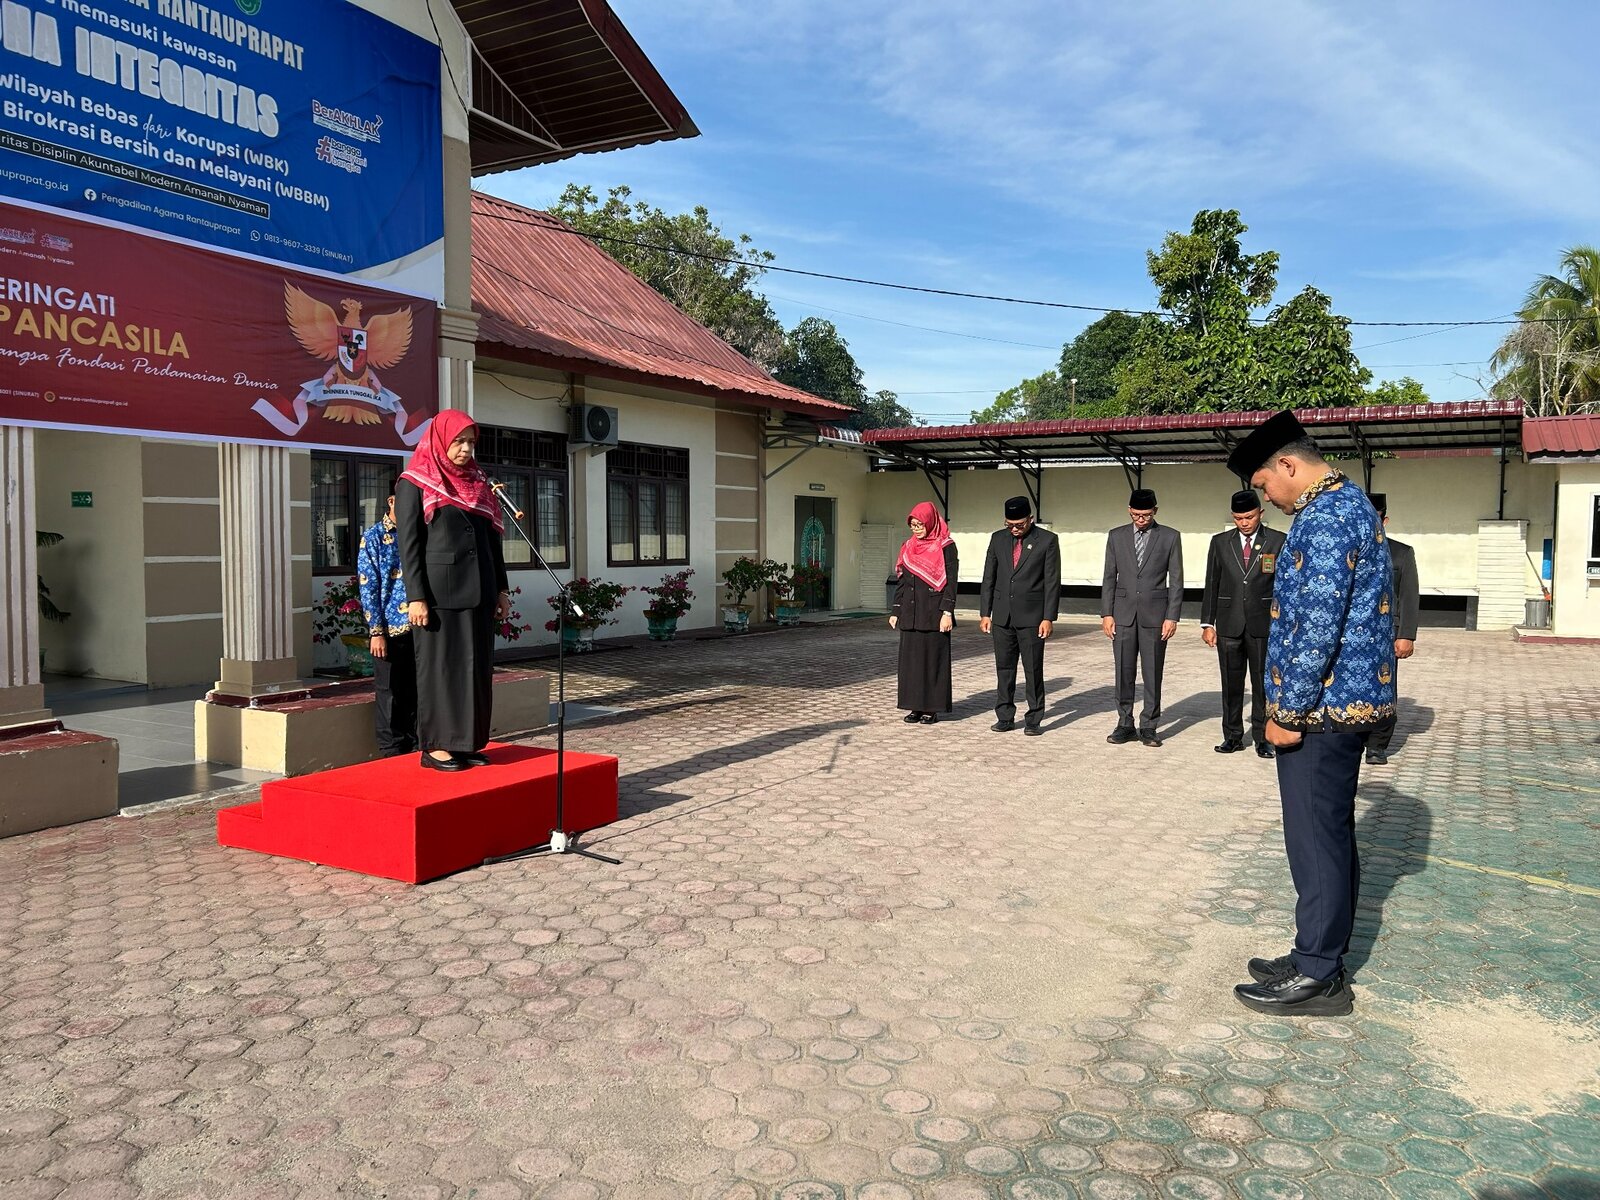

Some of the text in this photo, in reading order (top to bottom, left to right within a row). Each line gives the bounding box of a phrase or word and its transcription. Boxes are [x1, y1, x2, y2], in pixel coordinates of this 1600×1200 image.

[62, 0, 237, 73] memasuki kawasan
[157, 0, 304, 71] RANTAUPRAPAT
[0, 0, 279, 138] NA INTEGRITAS
[0, 73, 289, 176] Wilayah Bebas dari Korupsi (WBK)
[312, 99, 381, 138] BerAKHLAK
[0, 169, 69, 192] uprapat.go.id
[4, 100, 330, 212] Birokrasi Bersih dan Melayani (WBBM)
[32, 141, 77, 162] Disiplin
[80, 155, 138, 179] Akuntabel
[141, 171, 182, 190] Modern
[184, 183, 226, 203] Amanah
[229, 195, 267, 214] Nyaman
[101, 192, 241, 235] Pengadilan Agama Rantauprapat
[264, 232, 354, 264] 0813-9607-3339 (SINURAT)
[0, 304, 190, 359] PANCASILA
[56, 347, 125, 372] Fondasi
[132, 357, 228, 384] Perdamaian
[233, 372, 279, 391] Dunia
[350, 390, 373, 399] TUNGGAL
